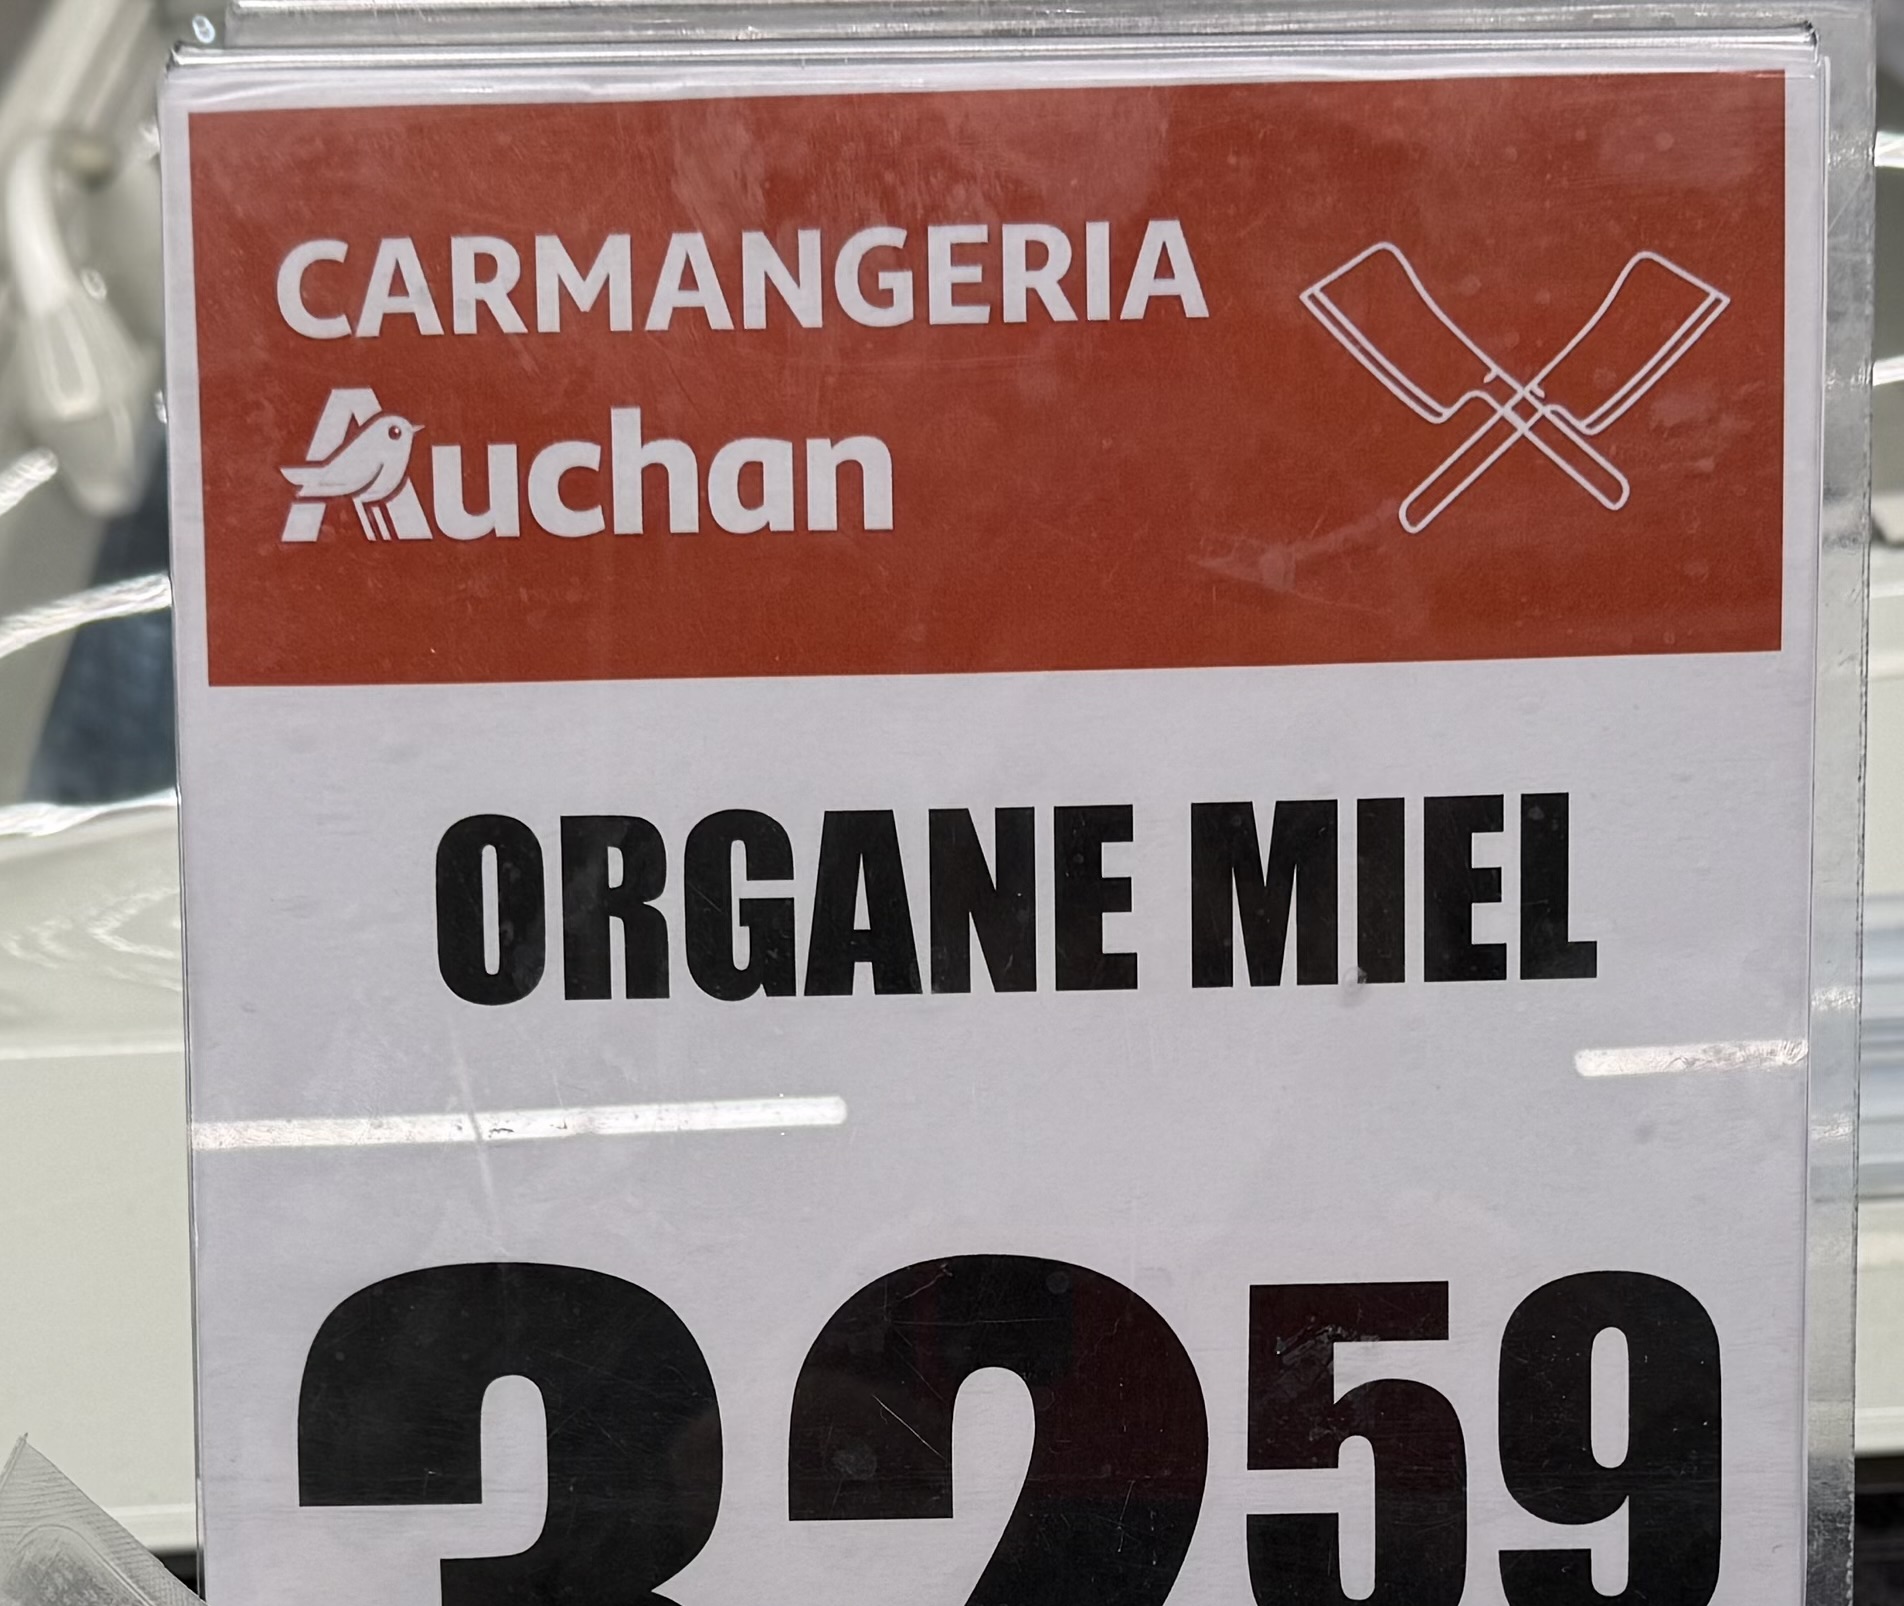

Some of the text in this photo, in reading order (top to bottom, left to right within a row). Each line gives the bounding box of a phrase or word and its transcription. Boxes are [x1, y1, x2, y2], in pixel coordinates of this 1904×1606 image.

[275, 218, 1212, 340] CARMANGERIA
[278, 387, 896, 544] Auchan
[433, 790, 1597, 1005] ORGANE MIEL
